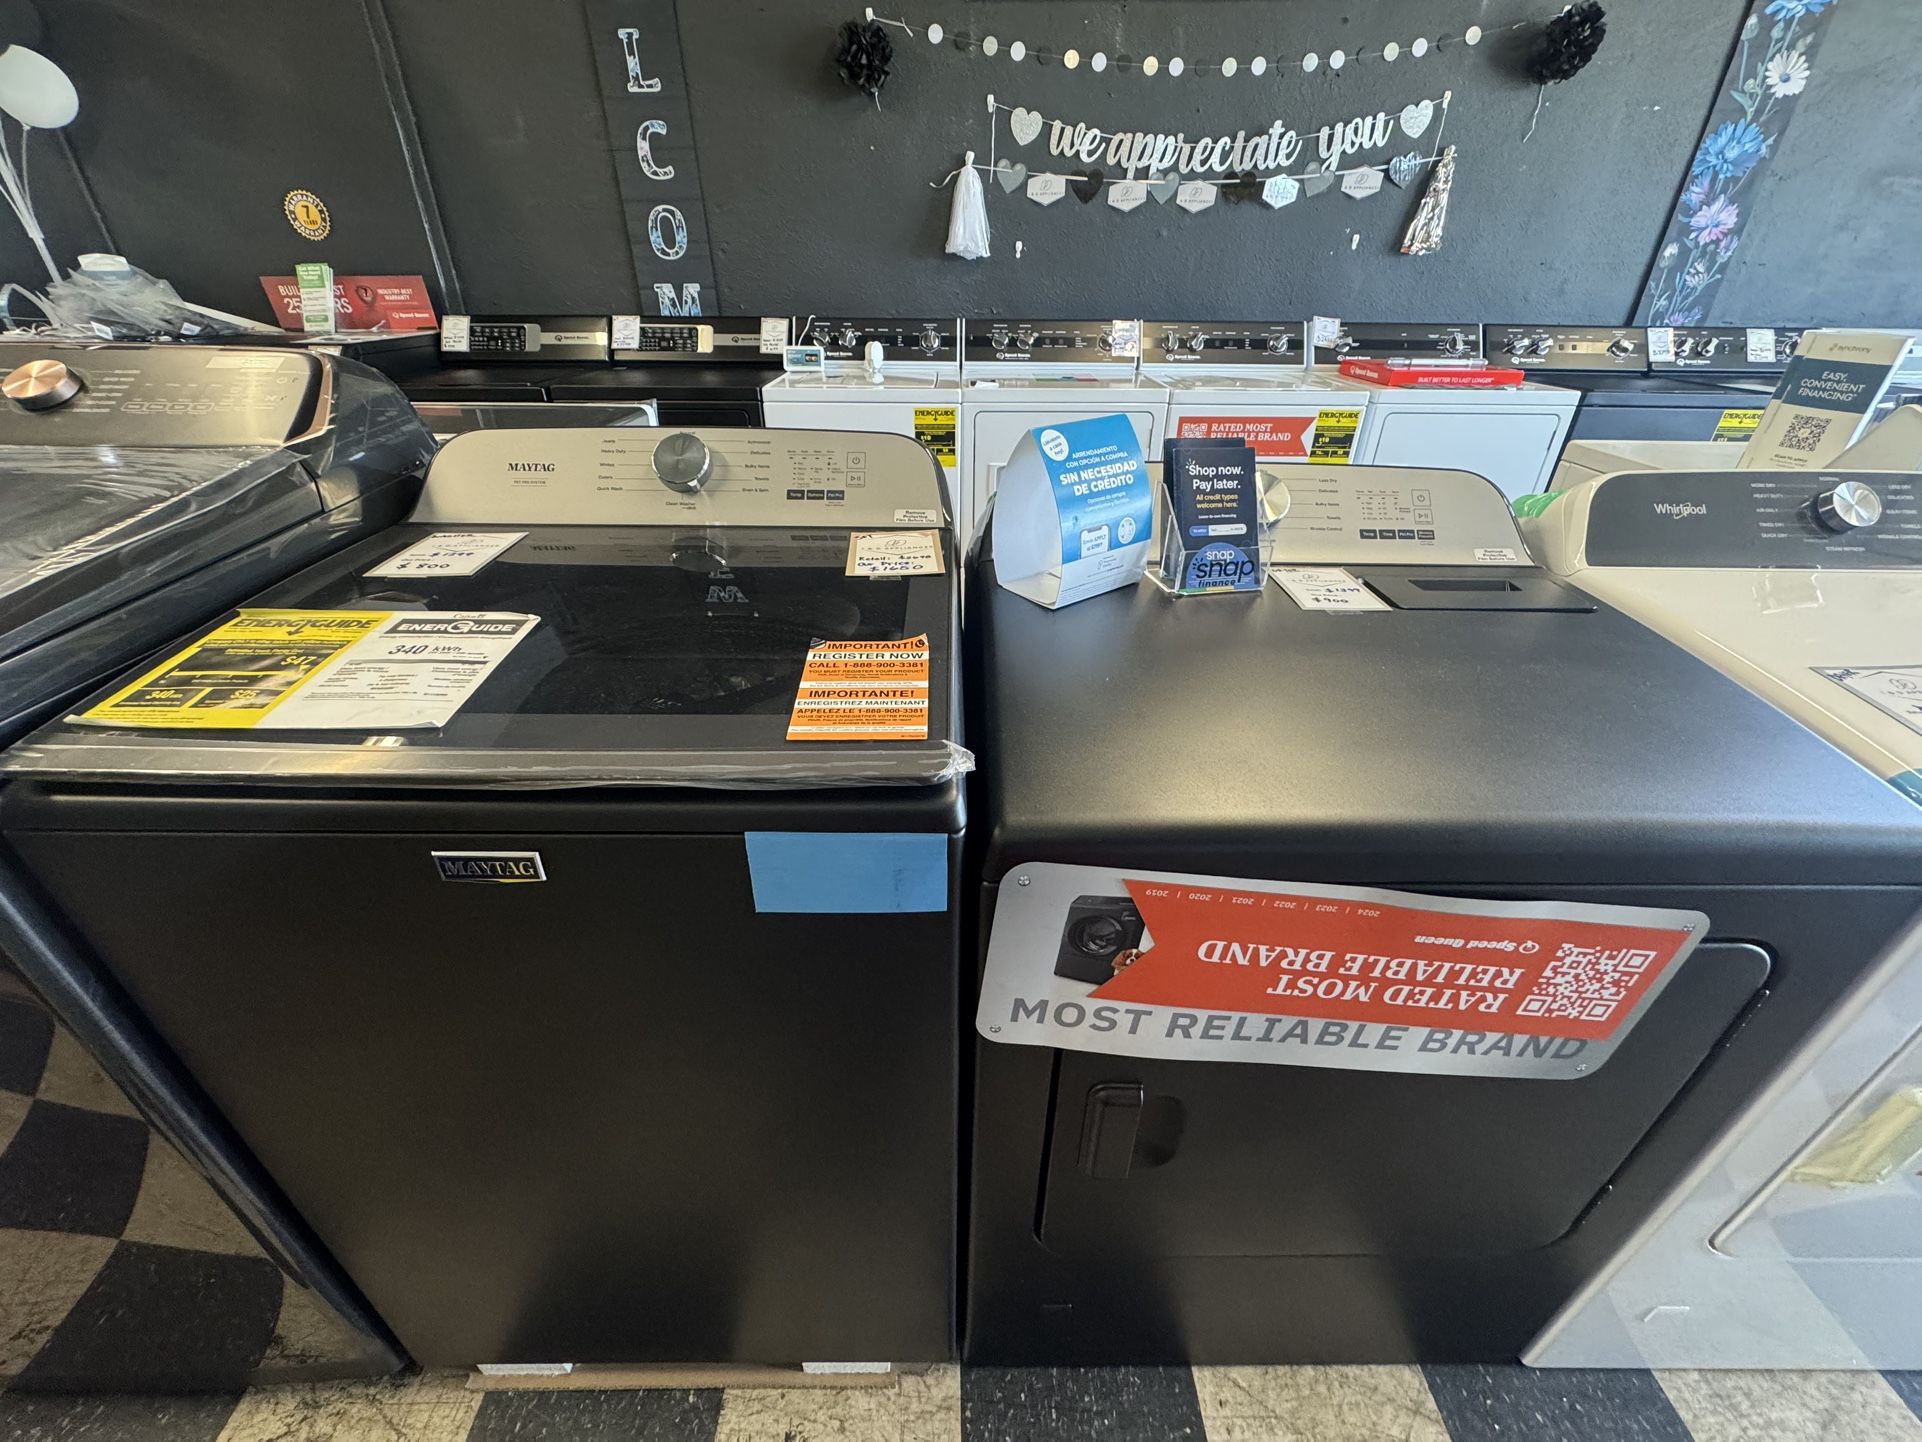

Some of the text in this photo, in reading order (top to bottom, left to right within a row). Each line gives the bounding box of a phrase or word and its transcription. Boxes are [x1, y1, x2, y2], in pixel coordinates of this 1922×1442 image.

[1049, 111, 1394, 190] we appreciate you
[287, 194, 322, 211] WARRANTY
[301, 205, 310, 219] 7
[294, 220, 327, 237] WARRANTY
[278, 285, 302, 296] BUIL
[1800, 378, 1866, 393] CONVENIENT
[915, 409, 956, 417] ENERGYGUIDE
[1318, 411, 1361, 420] ENERGYGUIDE
[1211, 423, 1274, 432] RATED MOST
[1257, 433, 1292, 441] BRAND
[1071, 444, 1118, 459] ARRENDAMIENTO
[1065, 460, 1079, 469] CON
[1078, 456, 1101, 467] OPCIÓN
[1105, 451, 1129, 462] COMPRA
[507, 462, 556, 473] MAYTAG
[1059, 460, 1138, 485] SIN NECESIDAD
[1188, 464, 1245, 477] Shop now.
[1072, 474, 1134, 496] DE CRÉDITO
[1192, 479, 1242, 492] Pay later.
[1221, 494, 1239, 502] types
[1653, 502, 1707, 517] Whirlpool
[1206, 550, 1236, 561] snap
[1195, 559, 1255, 583] snap
[1198, 578, 1237, 588] finance
[233, 617, 381, 630] ENERGYGUIDE
[396, 619, 517, 635] ENERGUIDE
[387, 644, 428, 655] 340
[827, 641, 914, 650] IMPORTANT!
[812, 652, 924, 660] REGISTER NOW
[145, 690, 176, 699] 340
[808, 690, 915, 698] IMPORTANTE!
[441, 861, 535, 876] MAYTAG
[1145, 889, 1381, 918] 2024 2023 2022 2021 2020 2019
[1414, 935, 1518, 953] Speed Queen
[1197, 939, 1525, 989] RELIABLE BRAND
[1266, 973, 1510, 1014] RATED MOST
[1009, 997, 1590, 1060] MOST RELIABLE BRAND
